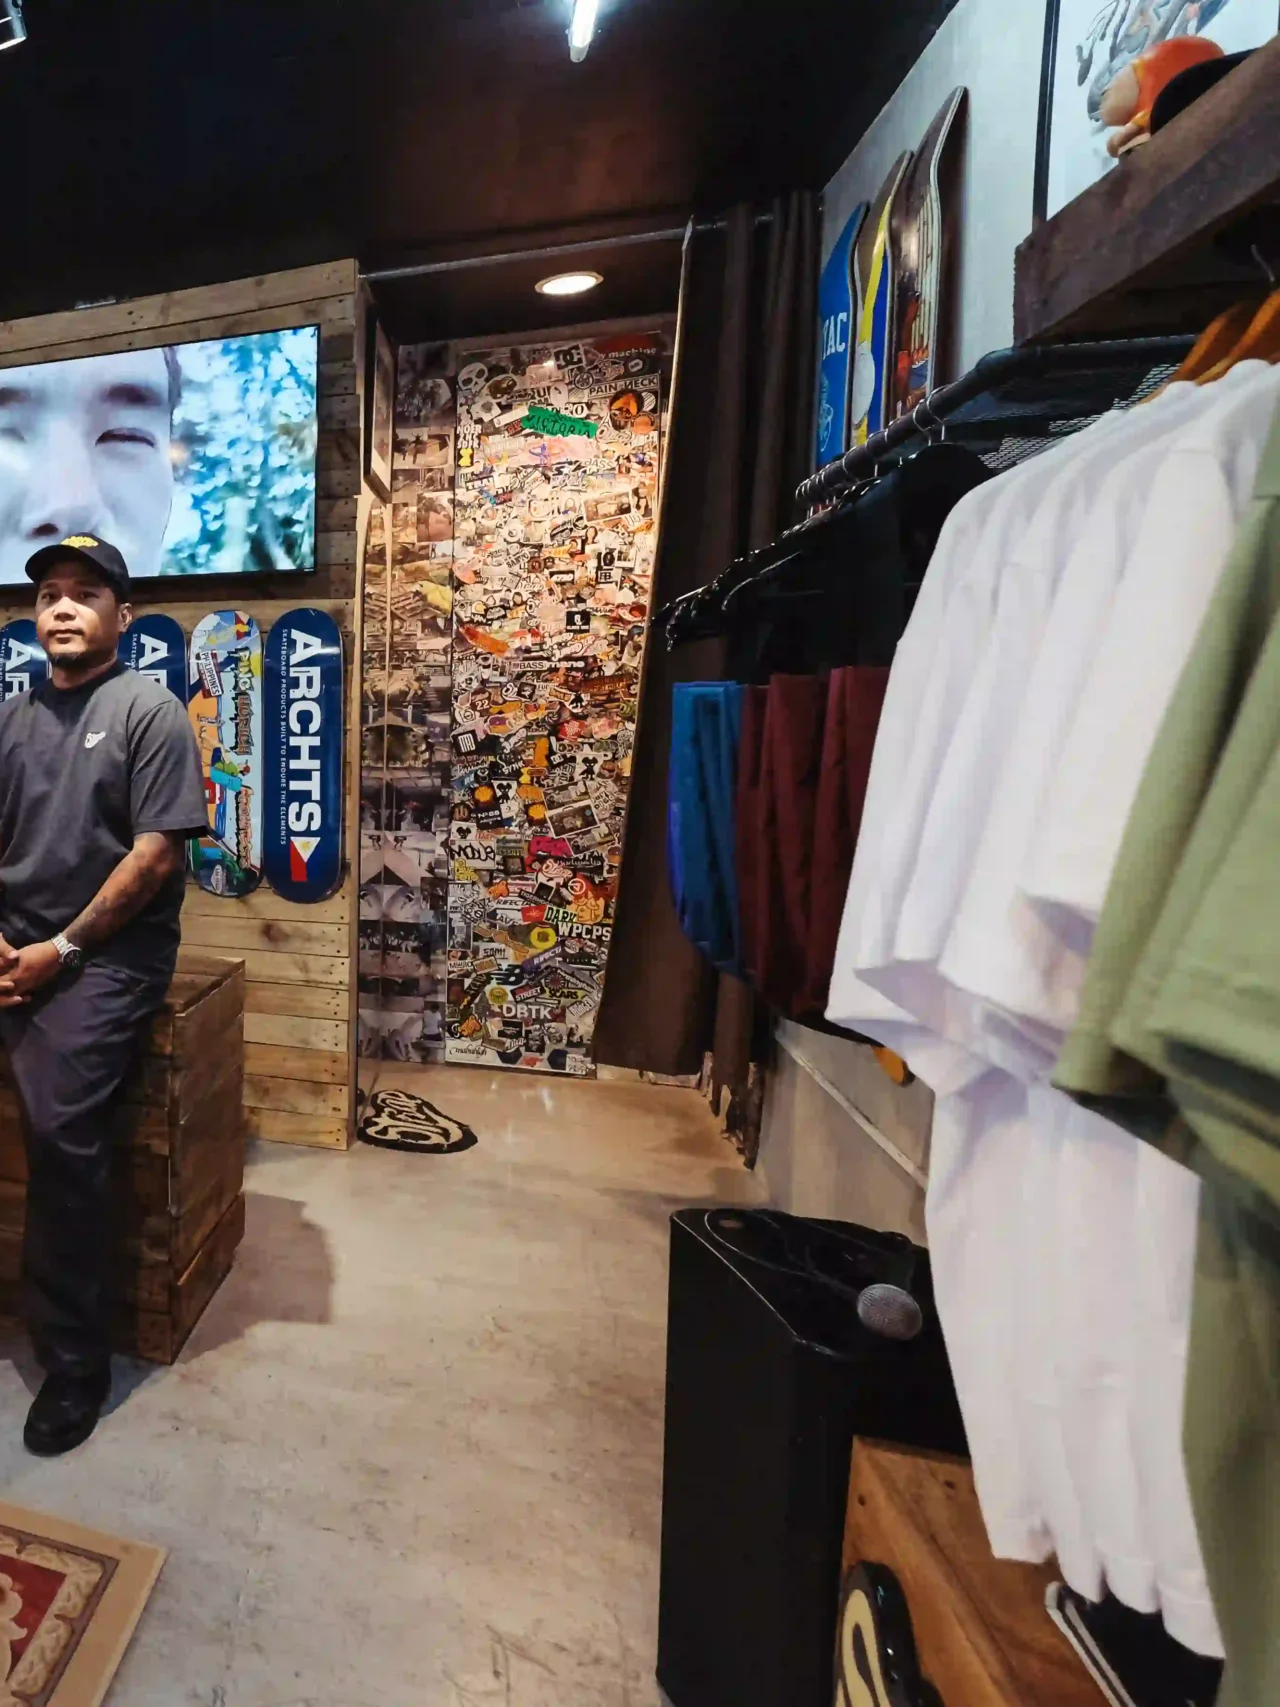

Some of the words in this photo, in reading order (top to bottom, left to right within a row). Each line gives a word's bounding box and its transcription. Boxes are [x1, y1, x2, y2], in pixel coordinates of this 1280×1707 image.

[589, 383, 618, 395] PAIN
[280, 628, 288, 676] SKATEBOARD
[201, 652, 220, 695] PHILIPPINES
[230, 648, 254, 691] PING
[280, 678, 288, 719] PRODUCTS
[475, 699, 490, 710] 22
[280, 721, 288, 742] BUILT
[288, 628, 322, 832] ARCHTS
[280, 744, 288, 755] TO
[280, 757, 288, 787] ENDURE
[280, 789, 288, 805] THE
[280, 806, 288, 845] ELEMENTS
[545, 906, 577, 922] DARK
[557, 921, 612, 941] WPCPS
[515, 986, 541, 1001] STREET
[502, 1003, 553, 1020] DBTK
